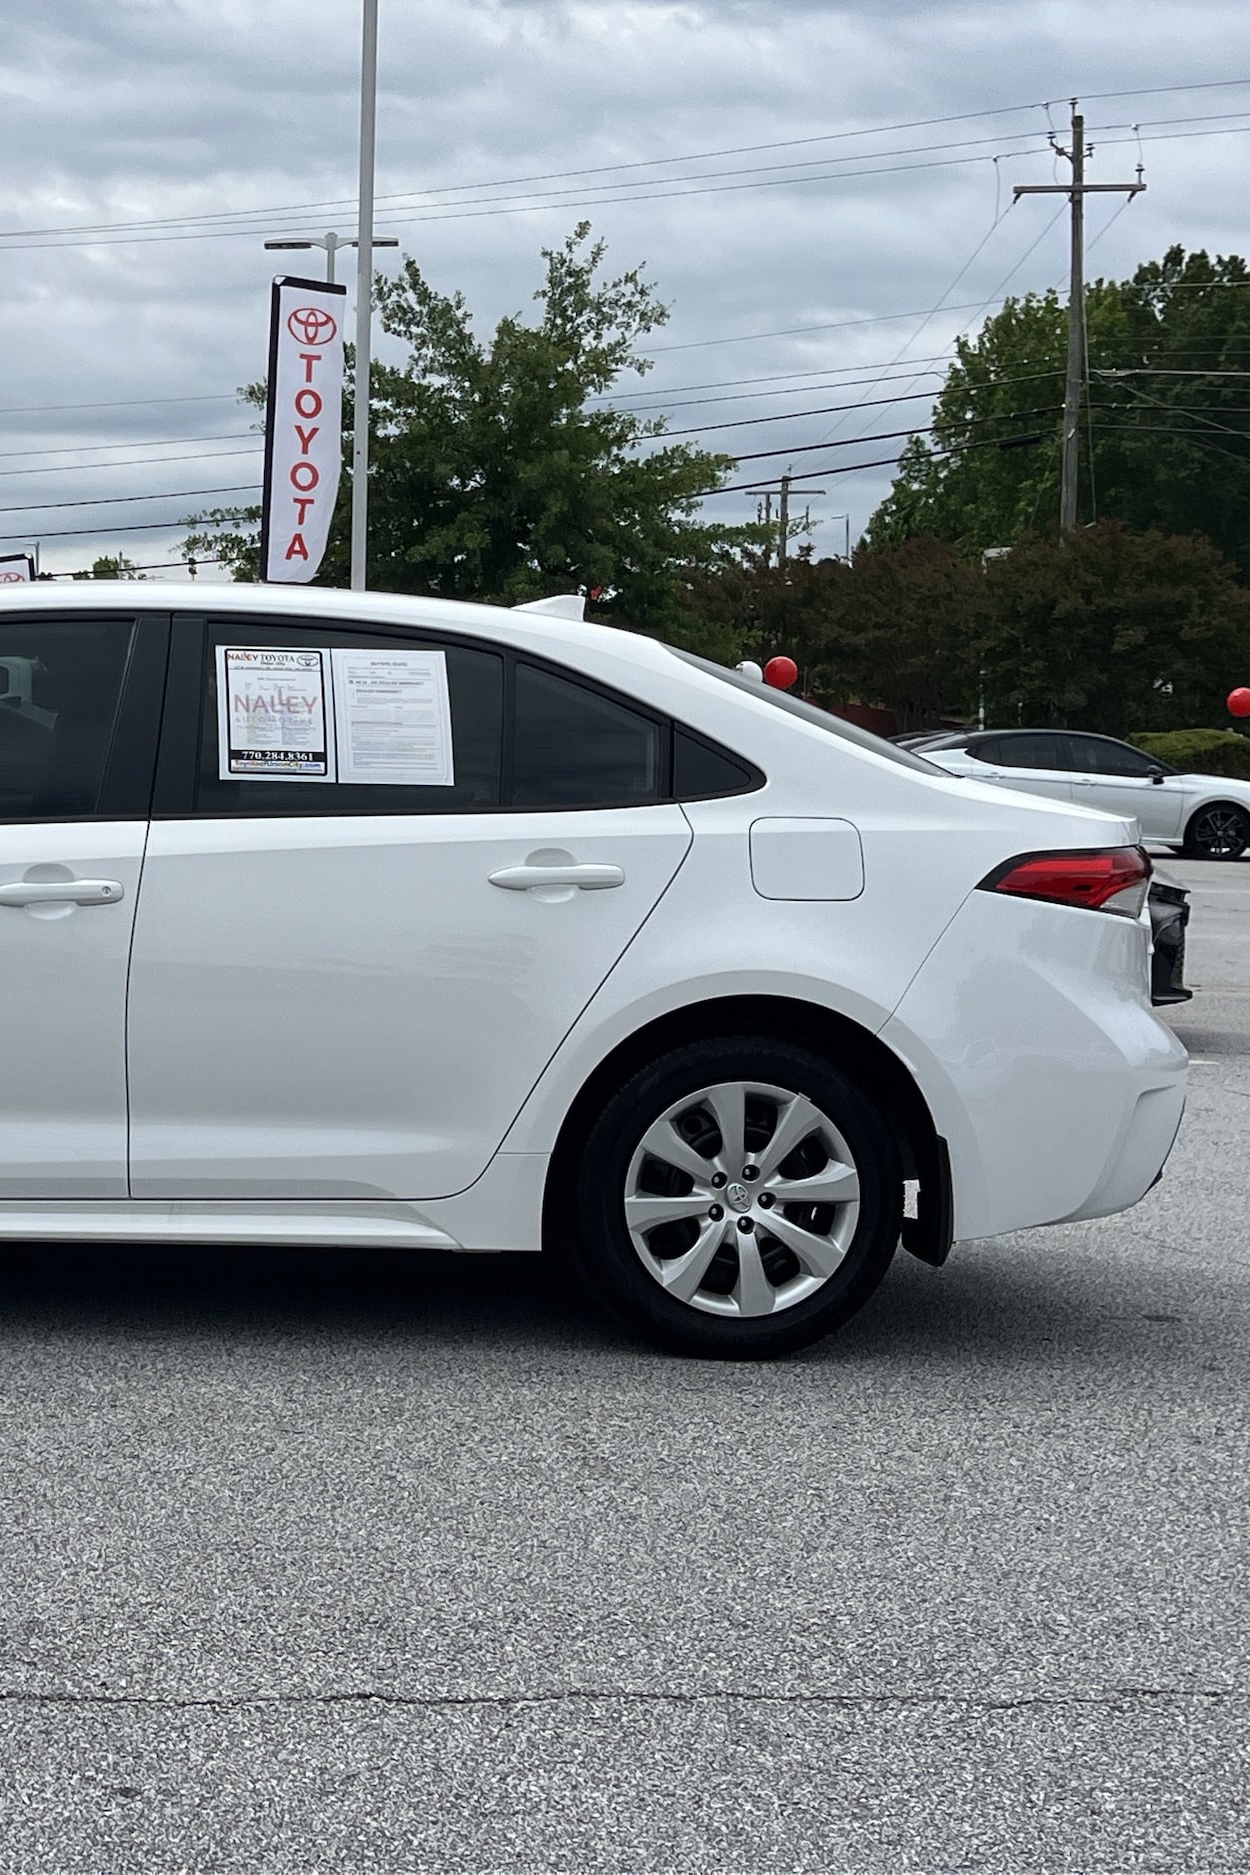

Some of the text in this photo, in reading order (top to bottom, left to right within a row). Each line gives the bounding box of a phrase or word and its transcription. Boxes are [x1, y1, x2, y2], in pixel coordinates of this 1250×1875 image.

[285, 353, 323, 561] TOYOTA
[227, 652, 295, 662] NALLEY TOYOTA
[234, 688, 318, 714] NALLEY
[242, 751, 314, 761] 770.284.8361
